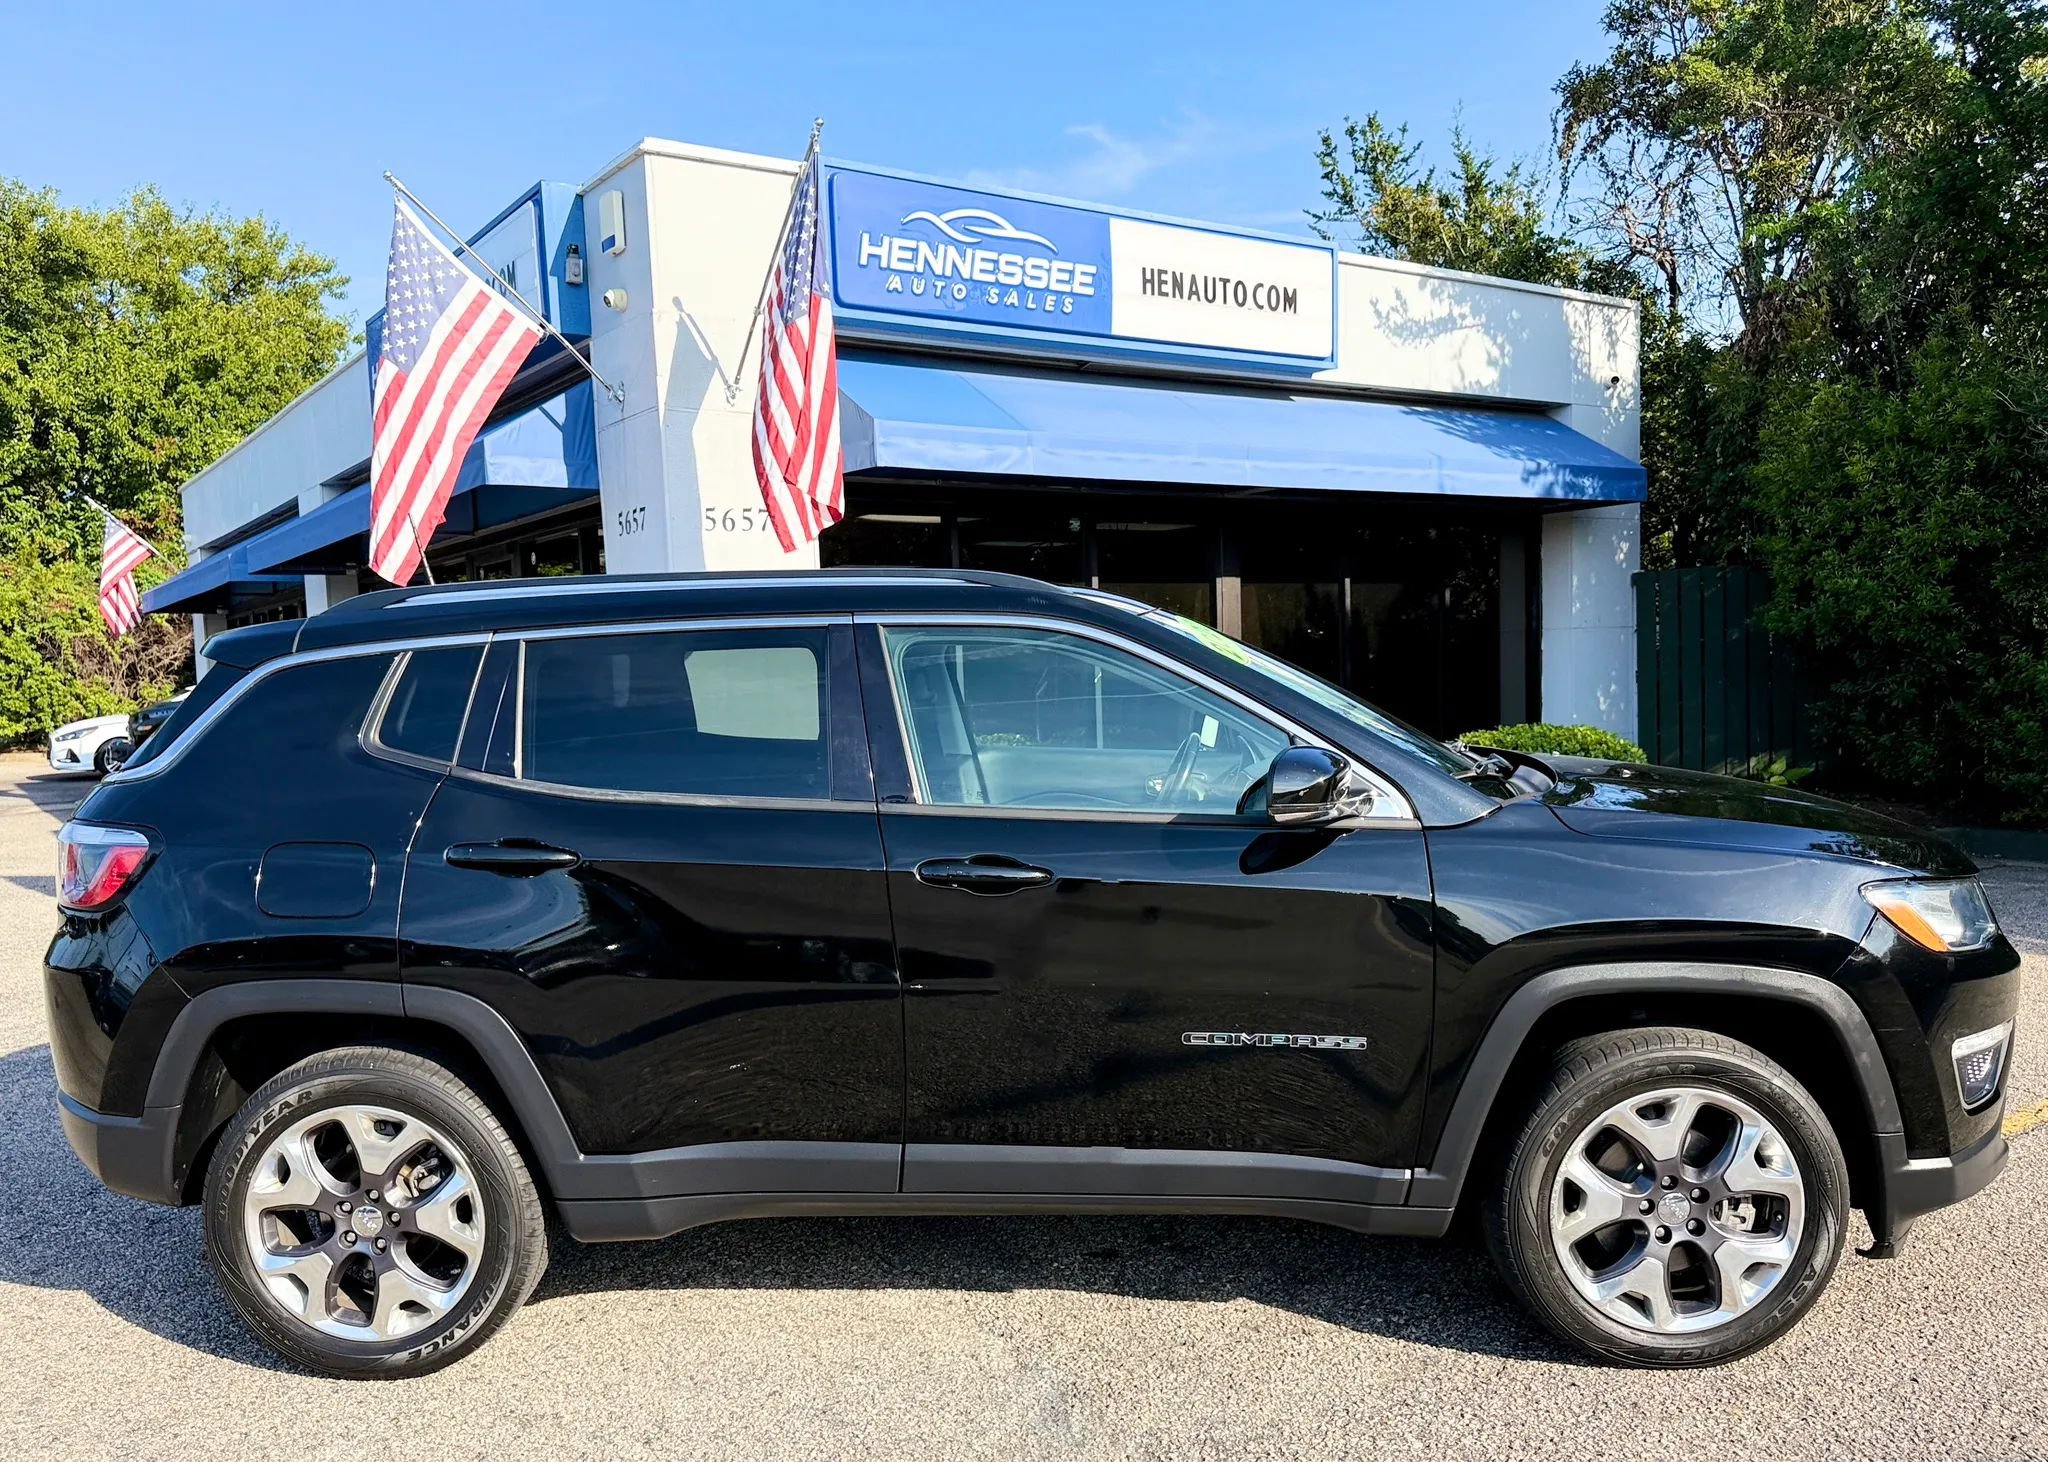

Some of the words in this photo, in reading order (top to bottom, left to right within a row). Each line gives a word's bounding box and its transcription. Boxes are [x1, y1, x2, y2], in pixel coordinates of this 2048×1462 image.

[858, 229, 1099, 297] HENNESSEE
[886, 275, 965, 301] AUTO
[986, 286, 1075, 315] SALES
[1141, 266, 1299, 315] HENAUTO.COM
[618, 506, 646, 537] 5657
[705, 506, 770, 533] 5657
[1181, 1031, 1368, 1051] COMPASS
[1542, 1063, 1697, 1158] GOOEAR
[217, 1090, 313, 1223] GOODYEAR
[1659, 1262, 1818, 1361] ASSUNCE
